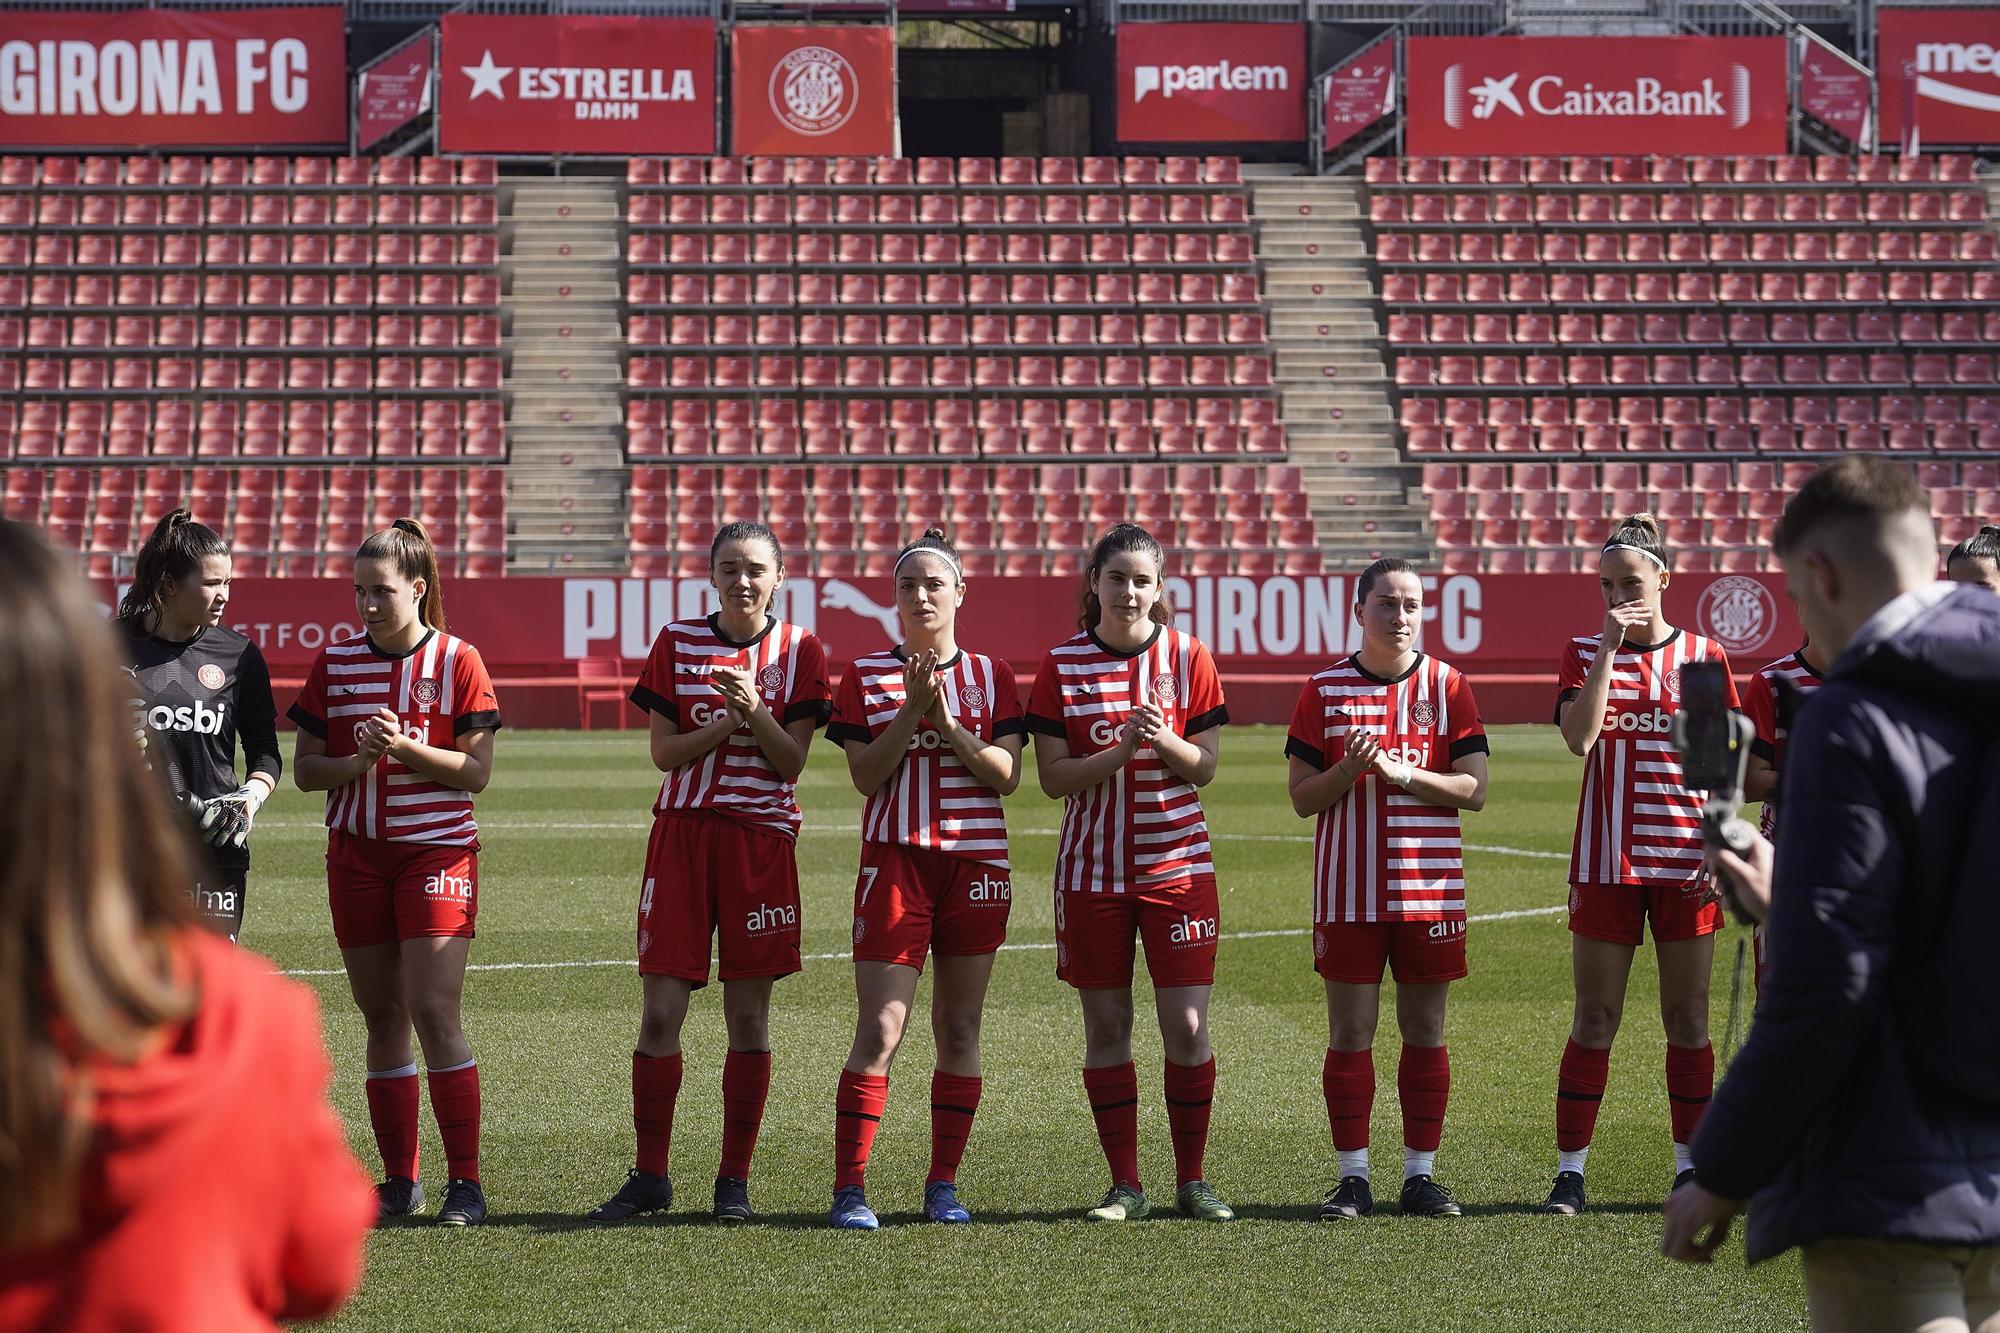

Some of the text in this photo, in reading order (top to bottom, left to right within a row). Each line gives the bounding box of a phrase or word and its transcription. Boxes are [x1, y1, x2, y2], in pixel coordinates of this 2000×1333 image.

[0, 38, 309, 116] GIRONA FC
[517, 67, 696, 101] ESTRELLA
[1163, 60, 1288, 98] parlem
[575, 101, 639, 120] DAMM
[1528, 76, 1726, 117] CaixaBank
[424, 869, 473, 898] alma
[640, 877, 656, 919] 4
[861, 867, 878, 907] 7
[969, 873, 1010, 900] alma
[747, 903, 796, 931] alma
[1055, 890, 1065, 932] 8
[1170, 914, 1217, 943] alma
